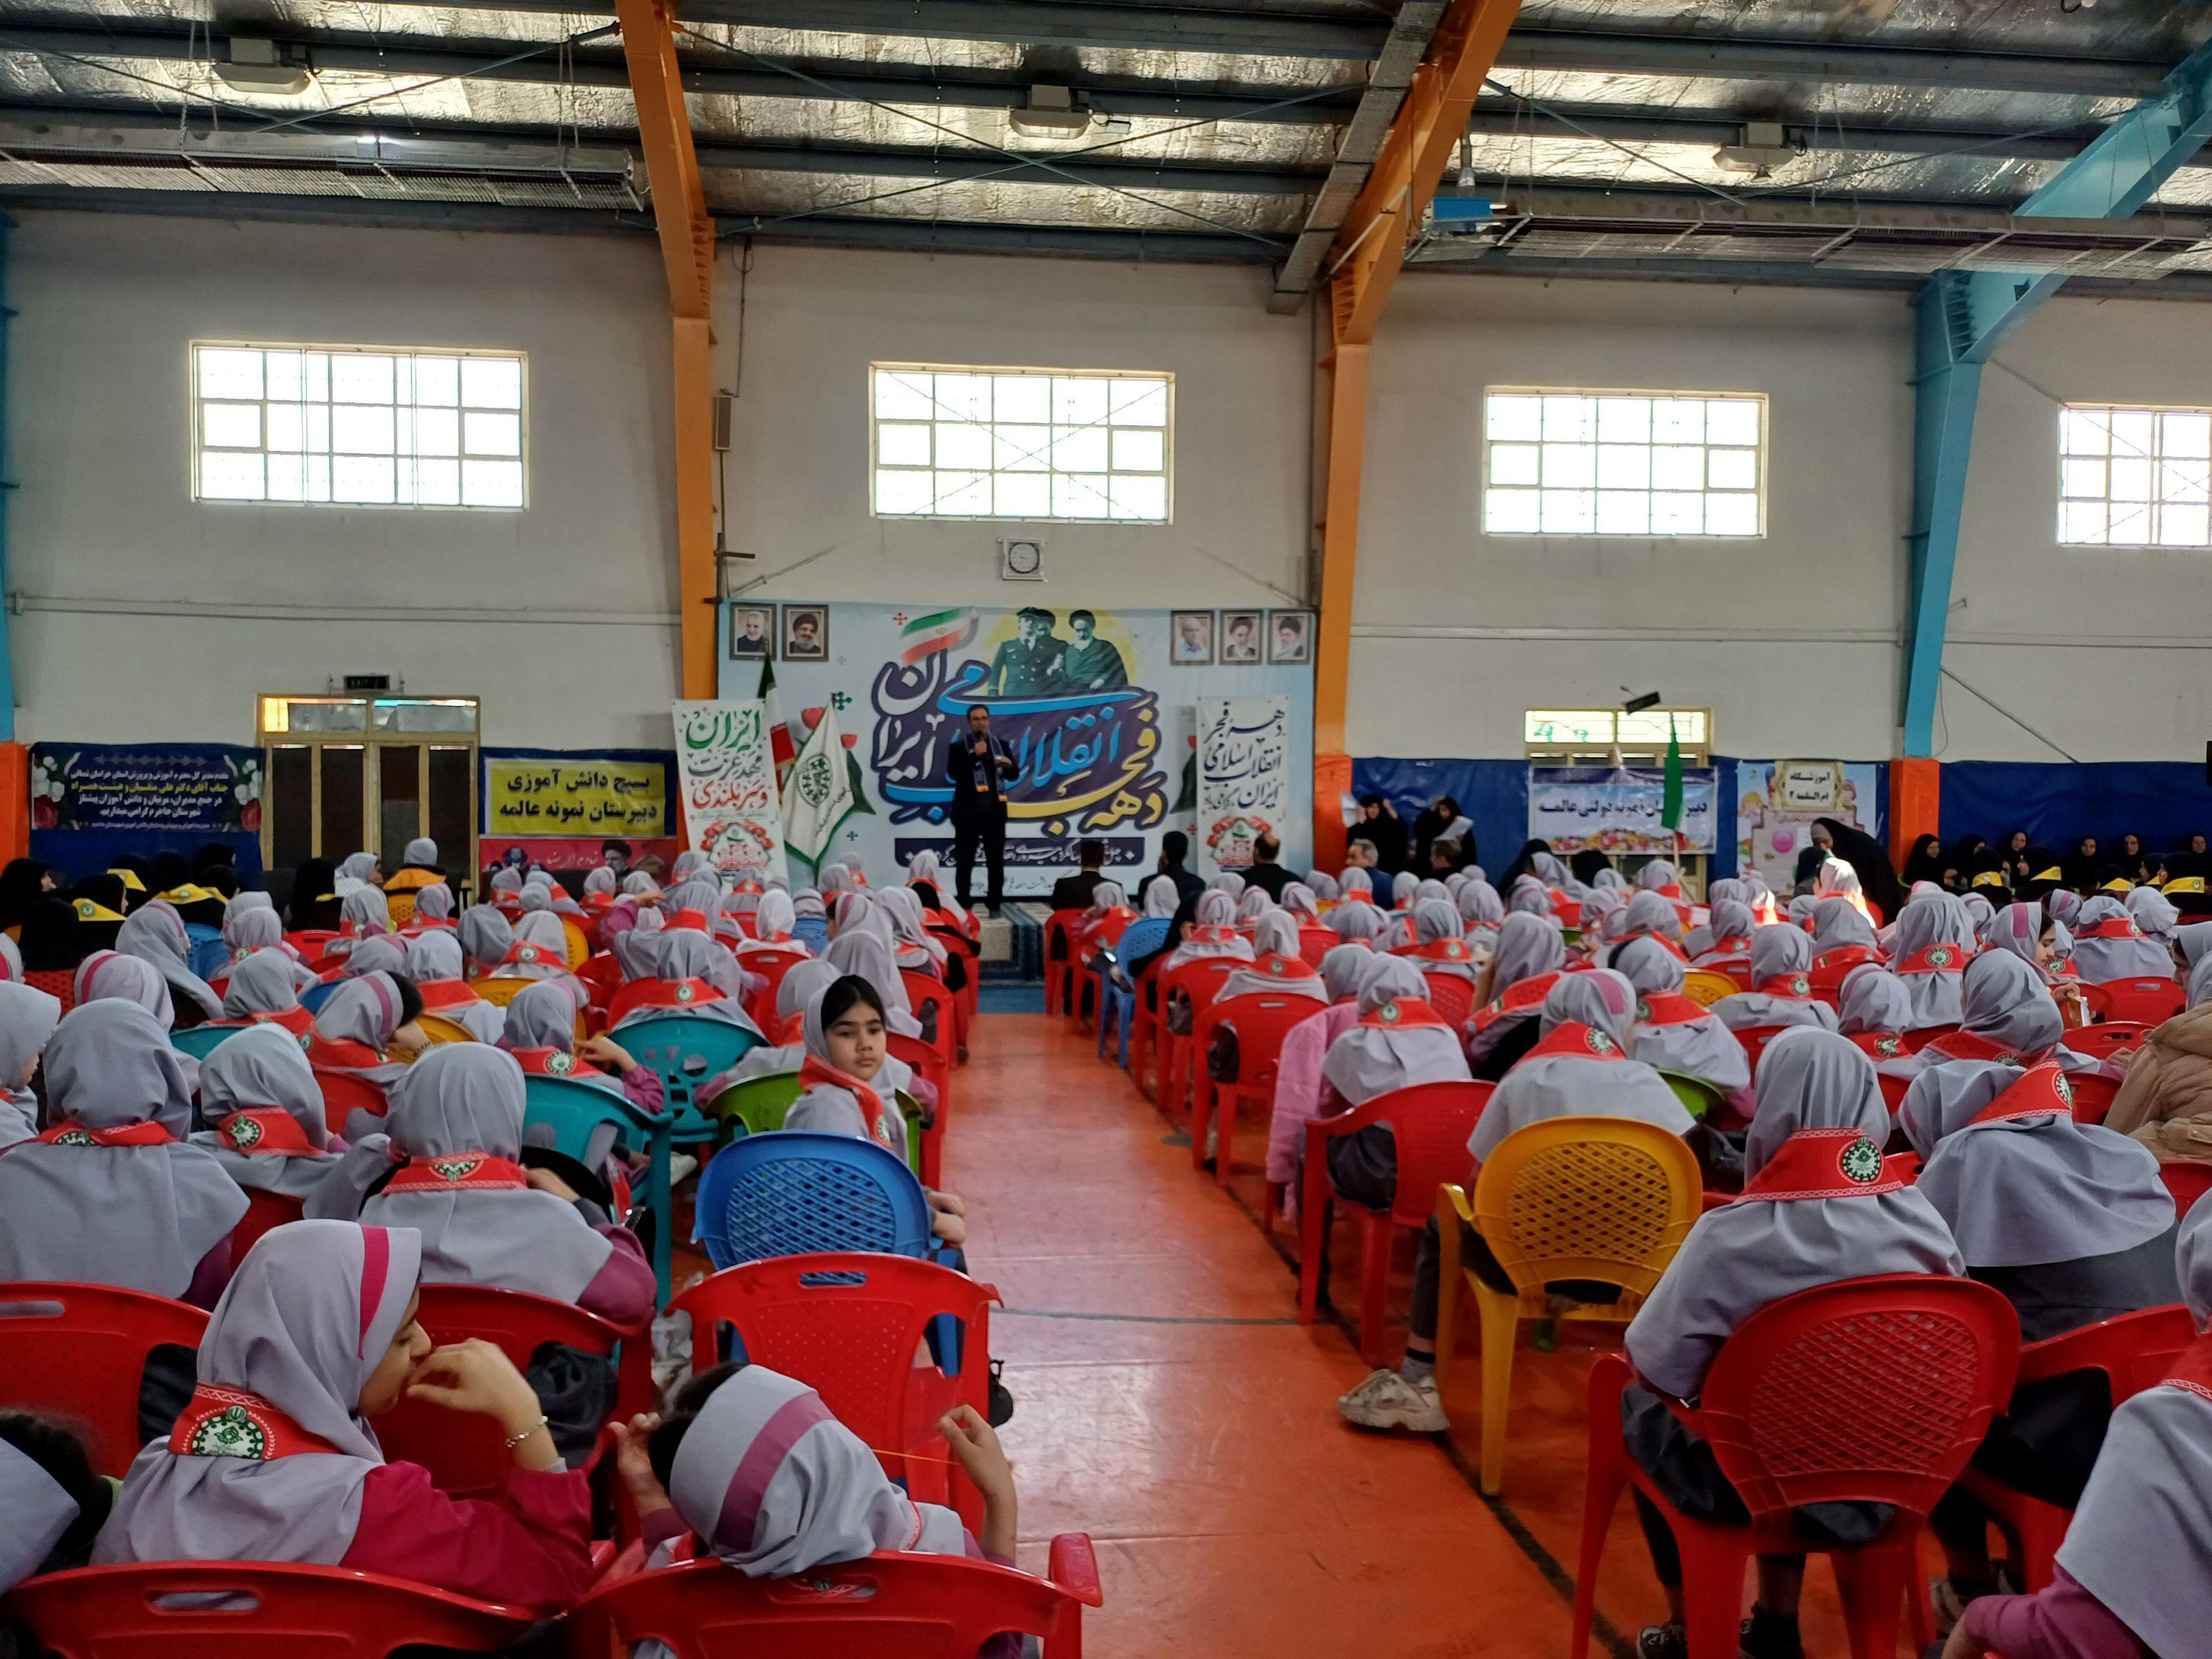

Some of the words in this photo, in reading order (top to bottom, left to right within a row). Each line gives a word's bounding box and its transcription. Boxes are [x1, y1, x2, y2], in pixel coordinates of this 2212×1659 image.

[877, 651, 941, 782] ایران
[686, 709, 760, 753] ایران
[507, 768, 561, 793] آموزی
[565, 771, 608, 793] دانش
[612, 775, 650, 794] بسیج
[499, 799, 541, 817] عالمه
[545, 799, 585, 823] نمونه
[589, 800, 657, 824] دبیرستان
[1083, 778, 1164, 830] دهه
